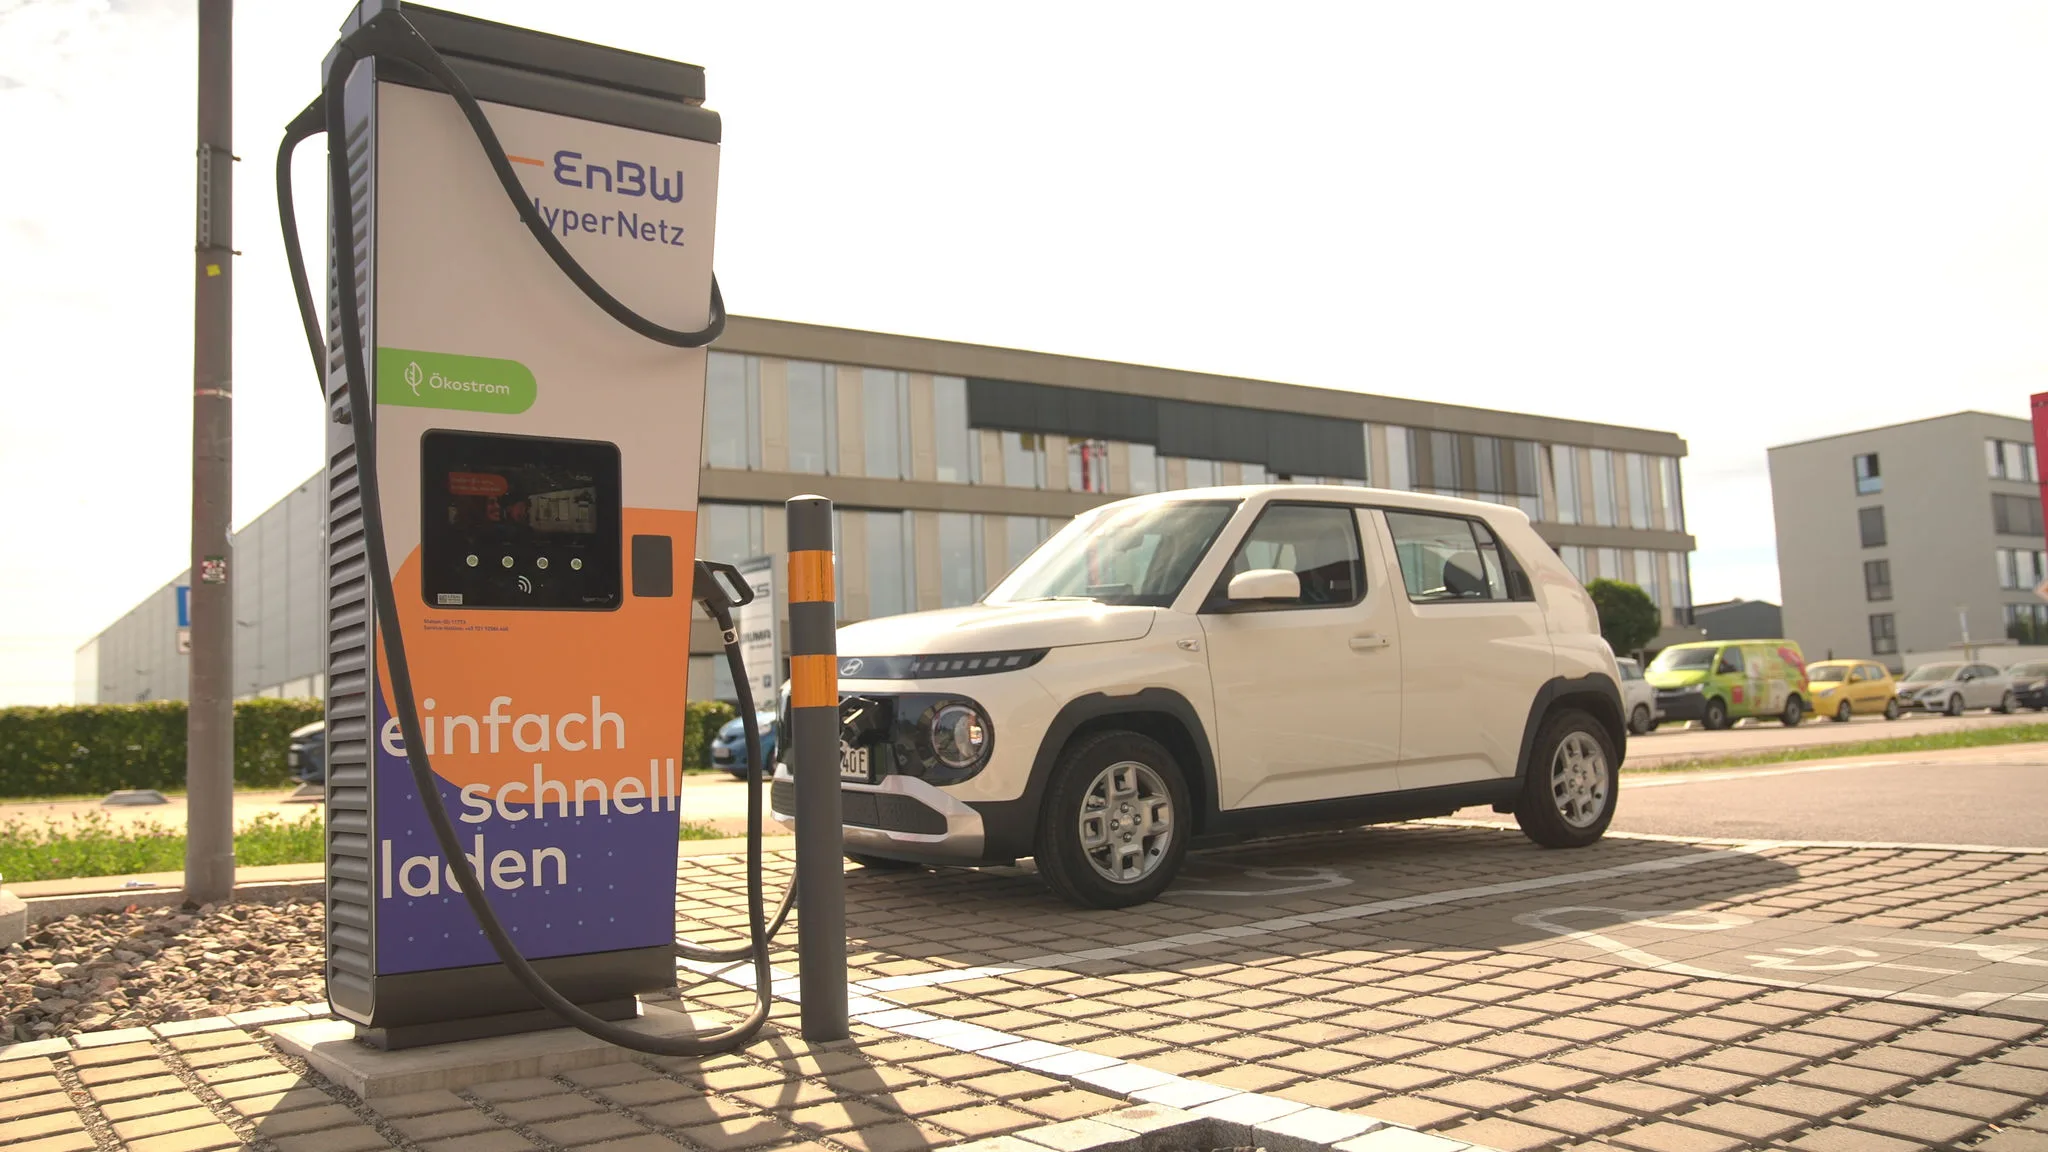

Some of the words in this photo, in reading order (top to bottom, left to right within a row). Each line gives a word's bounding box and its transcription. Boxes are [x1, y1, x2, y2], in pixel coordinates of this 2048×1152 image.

[553, 150, 684, 204] EnBW
[429, 372, 510, 395] Ökostrom
[380, 695, 625, 758] einfach
[459, 758, 676, 824] schnell
